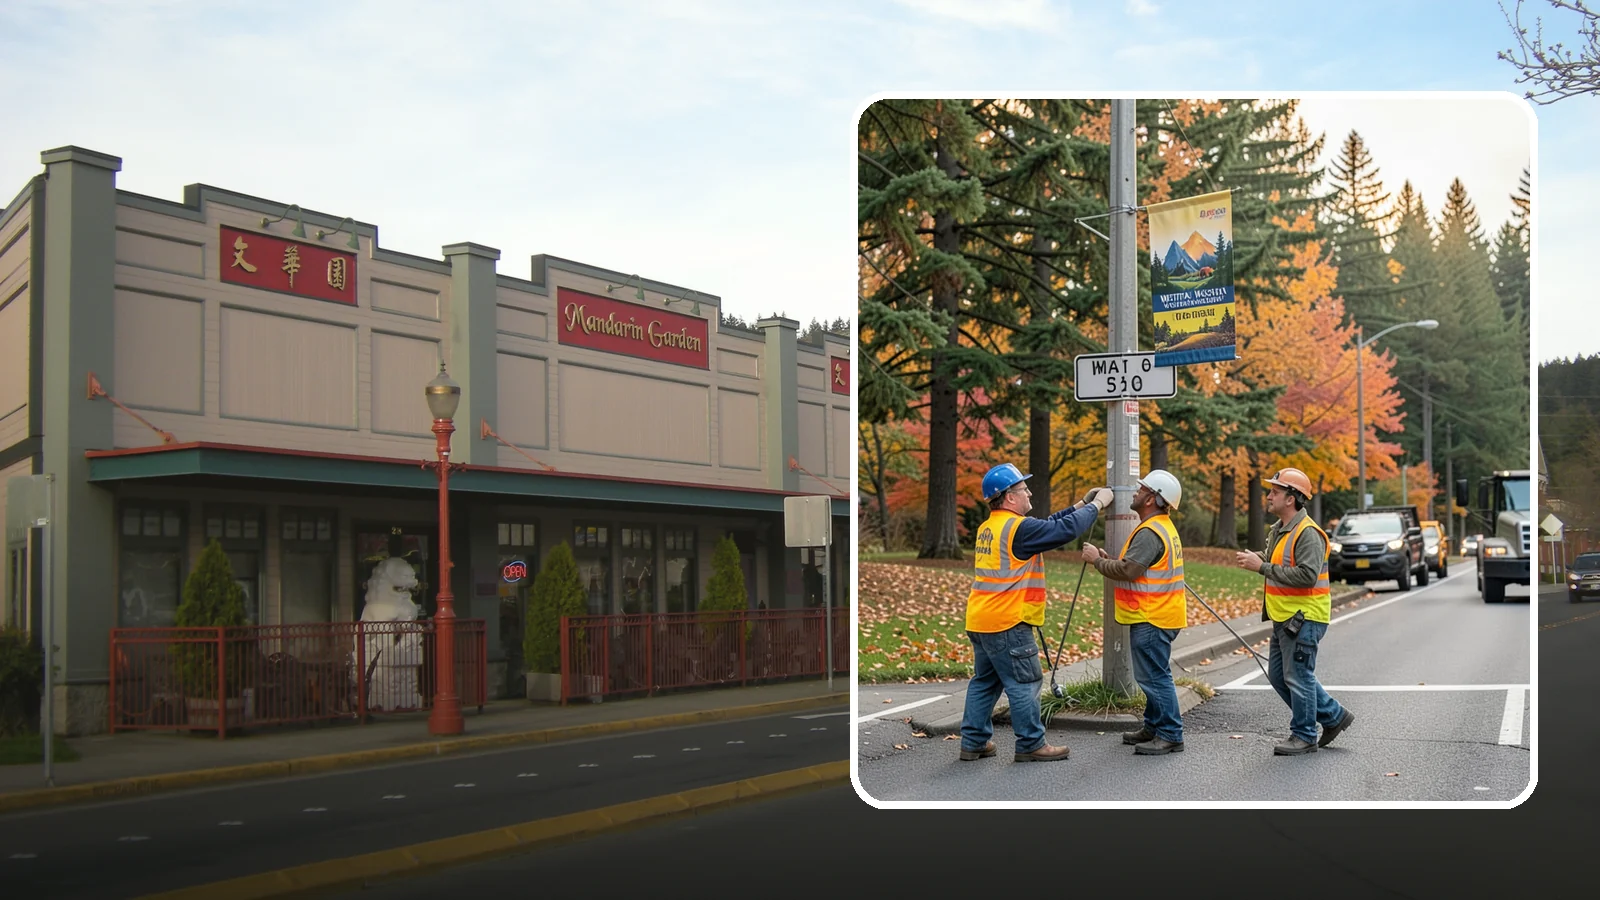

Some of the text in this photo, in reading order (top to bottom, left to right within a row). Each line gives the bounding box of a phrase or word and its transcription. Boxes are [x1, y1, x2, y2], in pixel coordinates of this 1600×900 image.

[231, 235, 347, 290] 文華園
[565, 302, 701, 352] Mandarin Garden
[834, 363, 846, 386] 文
[503, 565, 527, 578] OPEN
